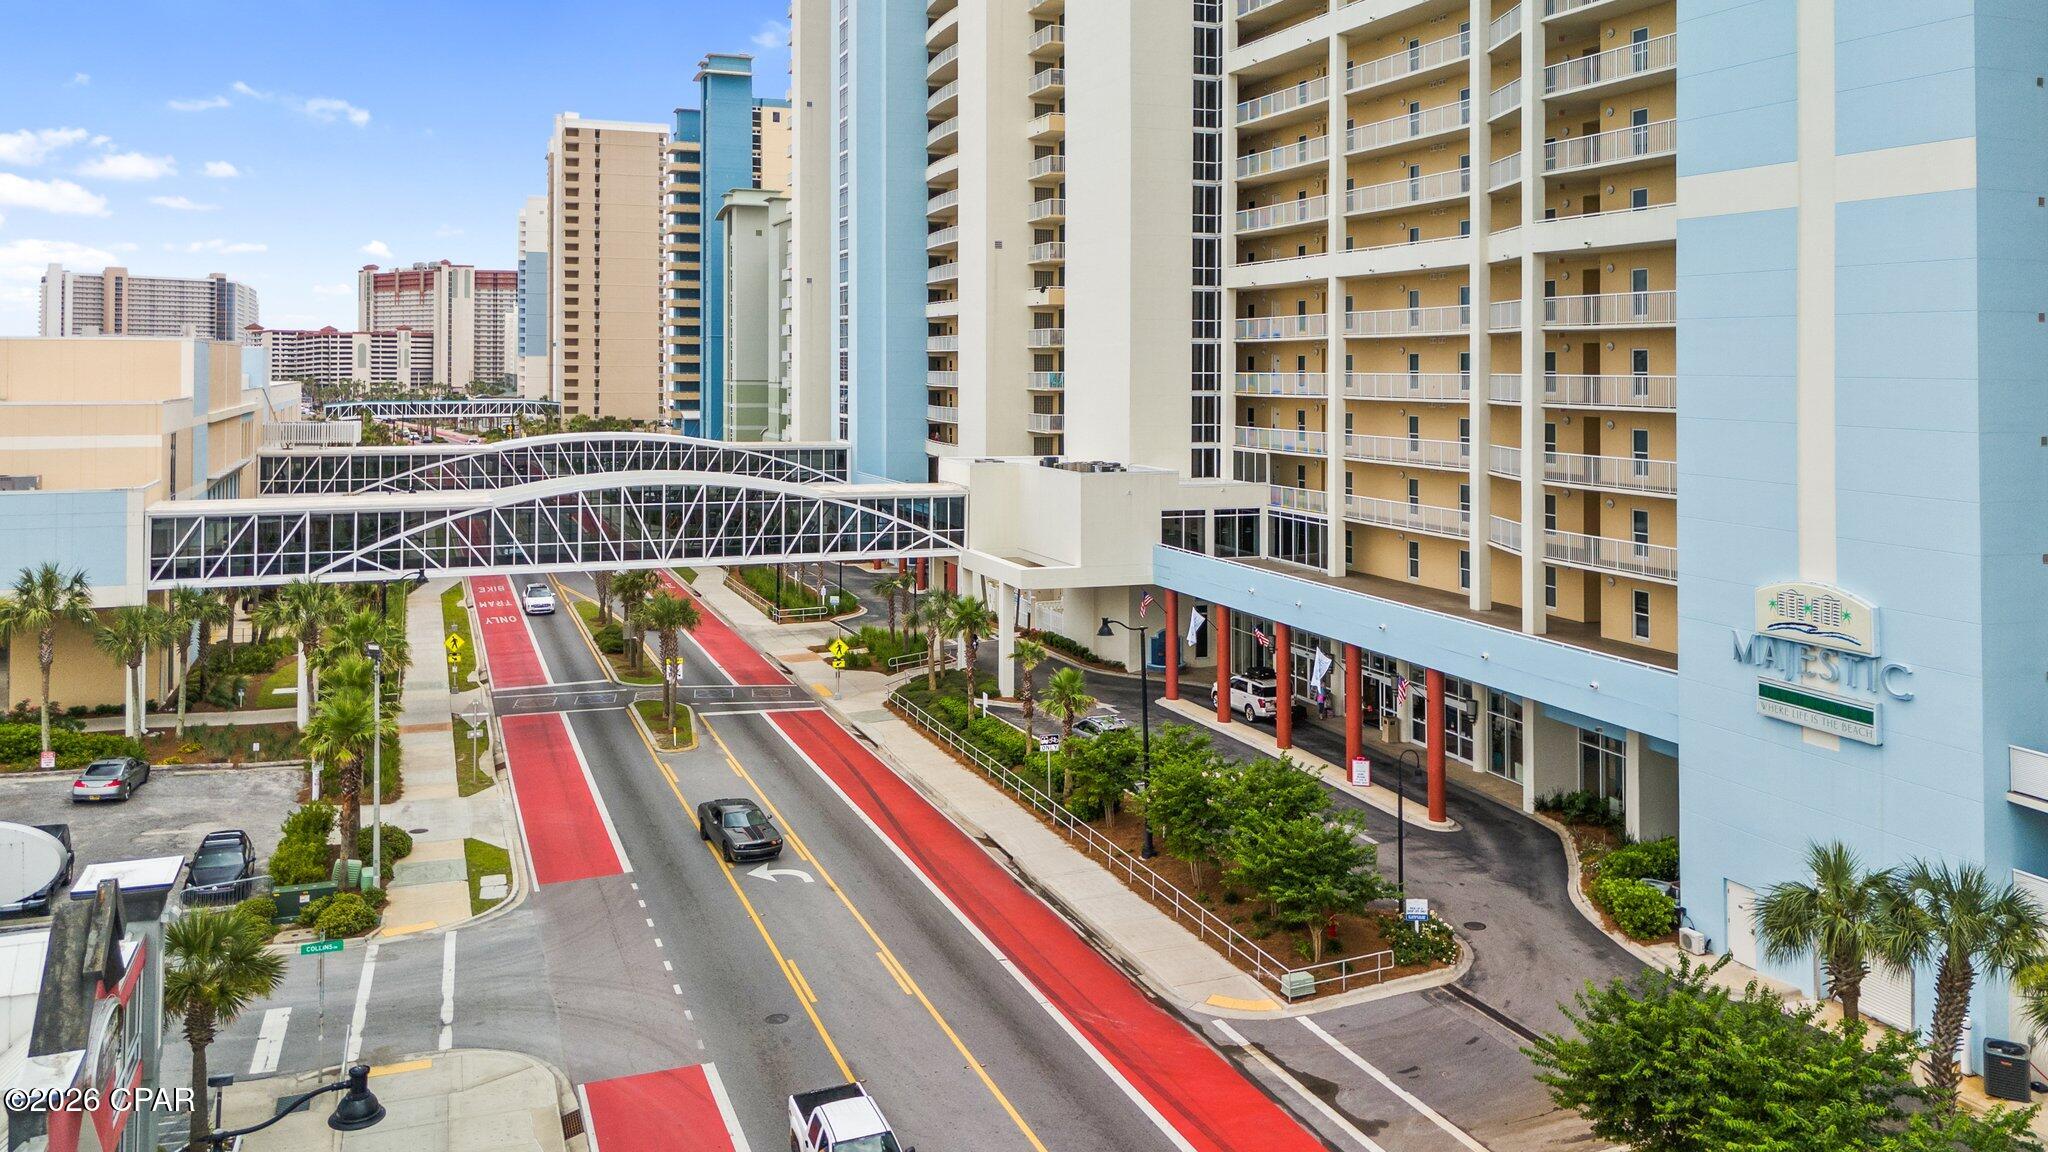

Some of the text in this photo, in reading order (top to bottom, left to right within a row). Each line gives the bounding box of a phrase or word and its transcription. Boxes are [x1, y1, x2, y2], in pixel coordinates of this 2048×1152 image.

[486, 615, 517, 624] ONLY
[1731, 629, 1914, 701] MAJESTIC
[1760, 701, 1873, 738] WHERE LIFE IS THE BEACH
[306, 944, 332, 952] COLLINS
